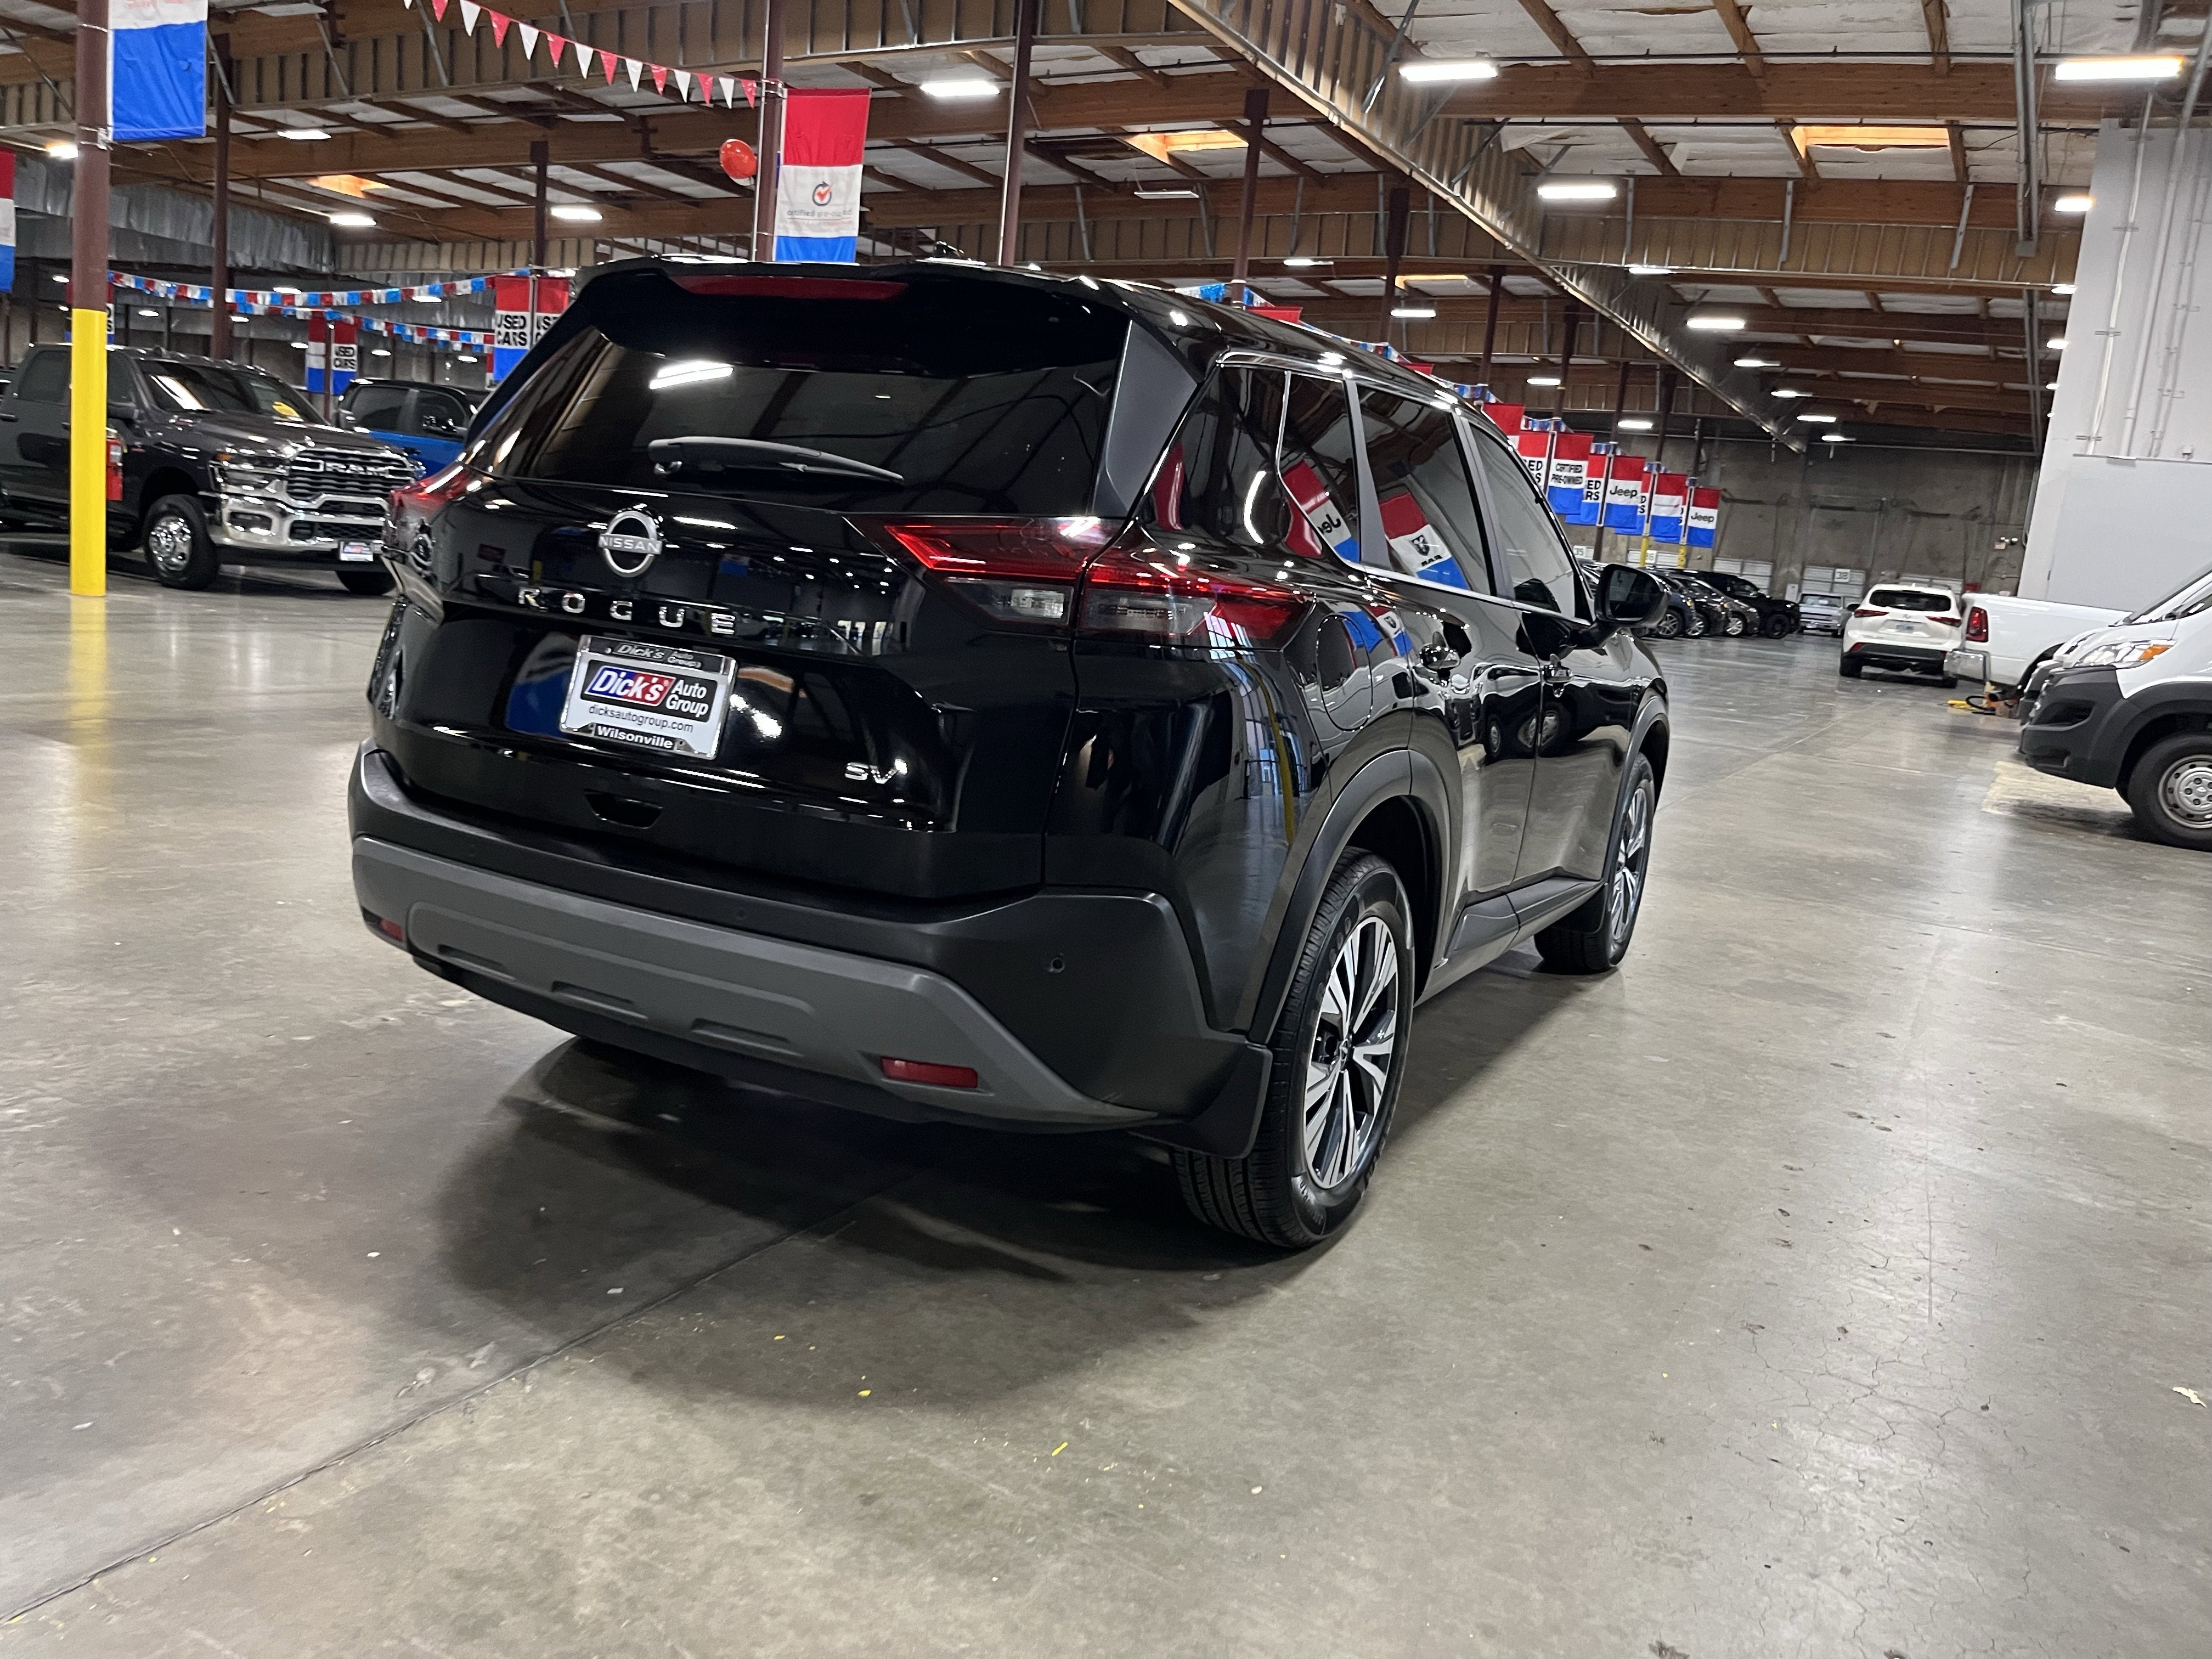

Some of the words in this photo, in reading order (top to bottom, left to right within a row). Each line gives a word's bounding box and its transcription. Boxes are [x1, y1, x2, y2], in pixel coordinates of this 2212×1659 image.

[326, 462, 387, 477] RAM
[1524, 460, 1543, 471] ED
[1610, 486, 1637, 499] Jeep
[1691, 512, 1714, 523] Jeep
[600, 536, 660, 554] NISSAN
[518, 586, 736, 635] ROGUE
[617, 644, 665, 659] Dick's
[592, 669, 664, 702] Dick's
[671, 679, 707, 699] Auto
[665, 694, 709, 718] Group
[589, 704, 693, 733] dicksautogroup.com
[597, 725, 673, 749] Wilsonville
[845, 761, 899, 785] SV
